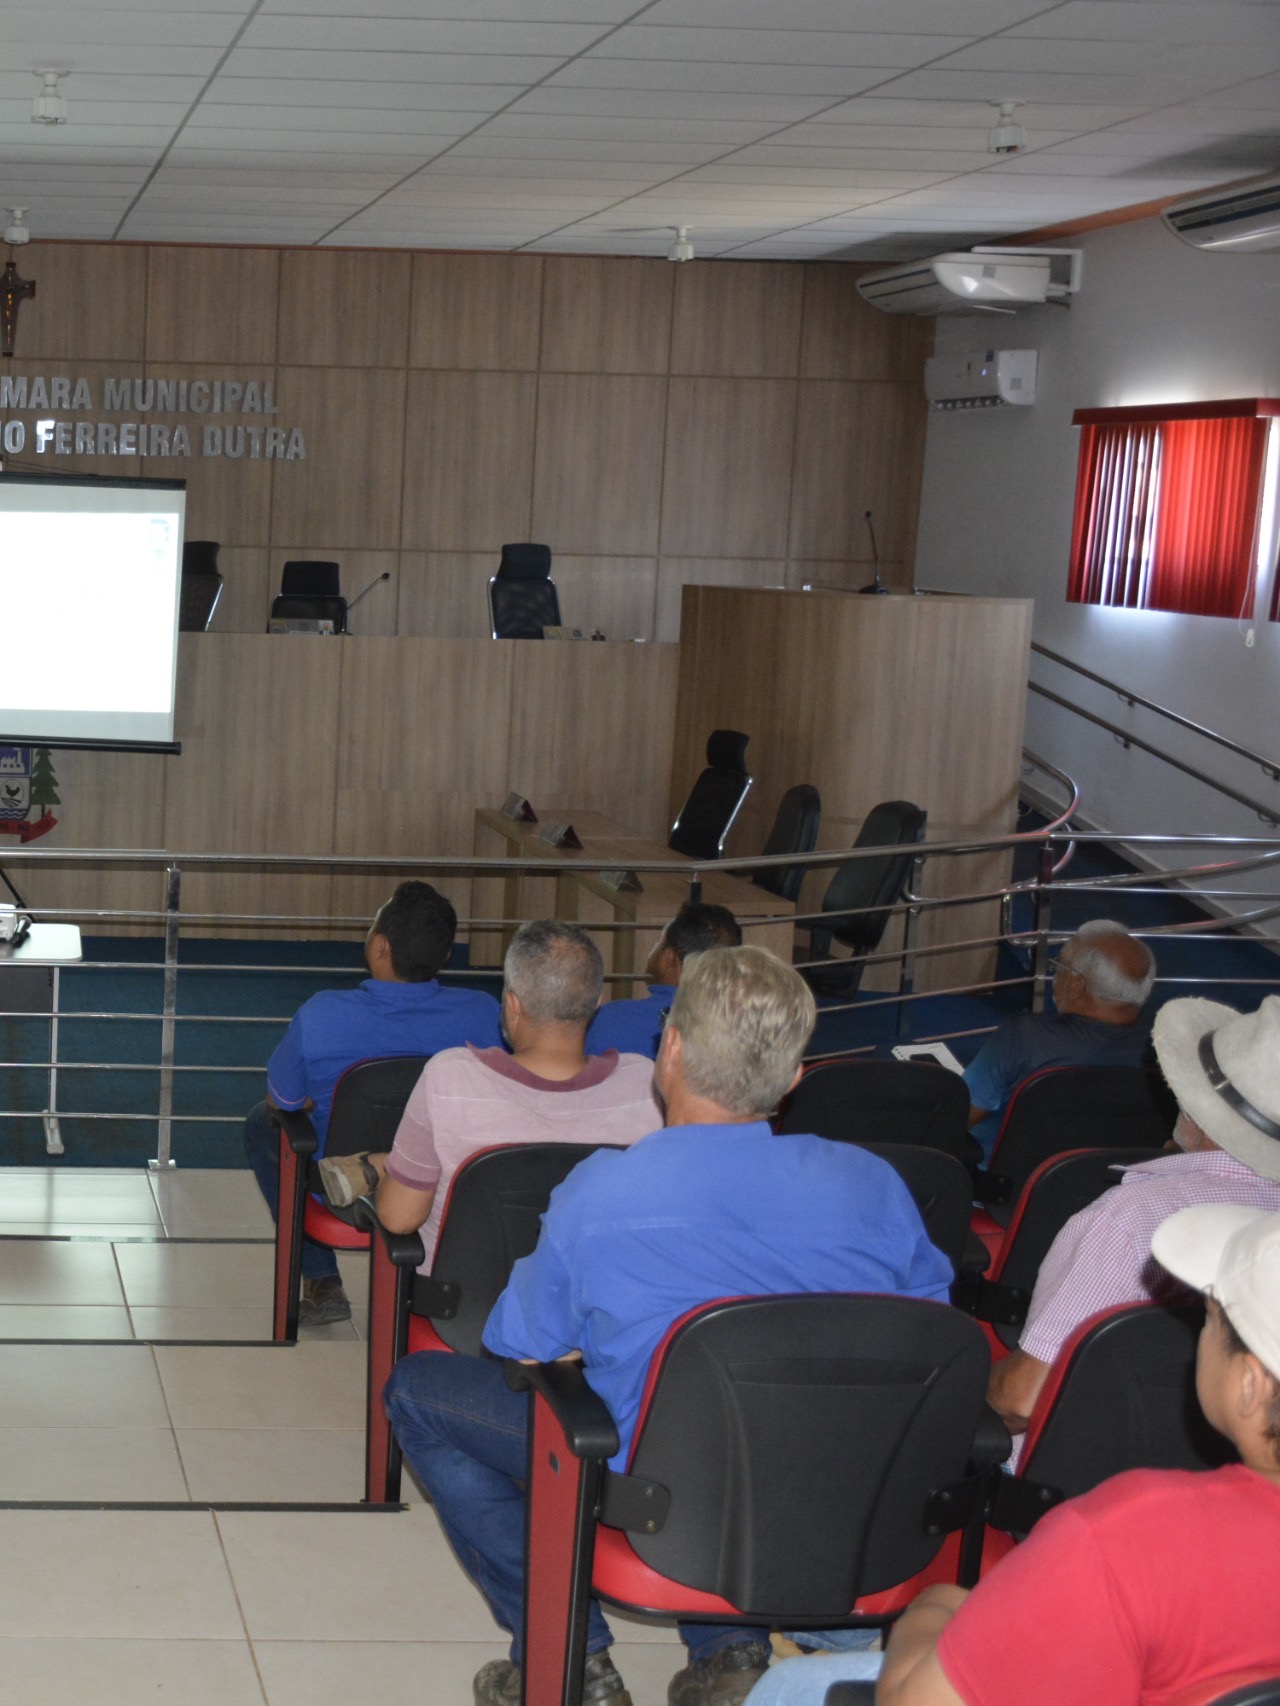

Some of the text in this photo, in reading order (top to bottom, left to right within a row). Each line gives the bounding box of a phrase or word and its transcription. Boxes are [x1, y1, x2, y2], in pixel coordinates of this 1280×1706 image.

[104, 378, 278, 414] MUNICIPAL
[36, 419, 191, 457] FERREIRA
[203, 425, 306, 460] DUTRA
